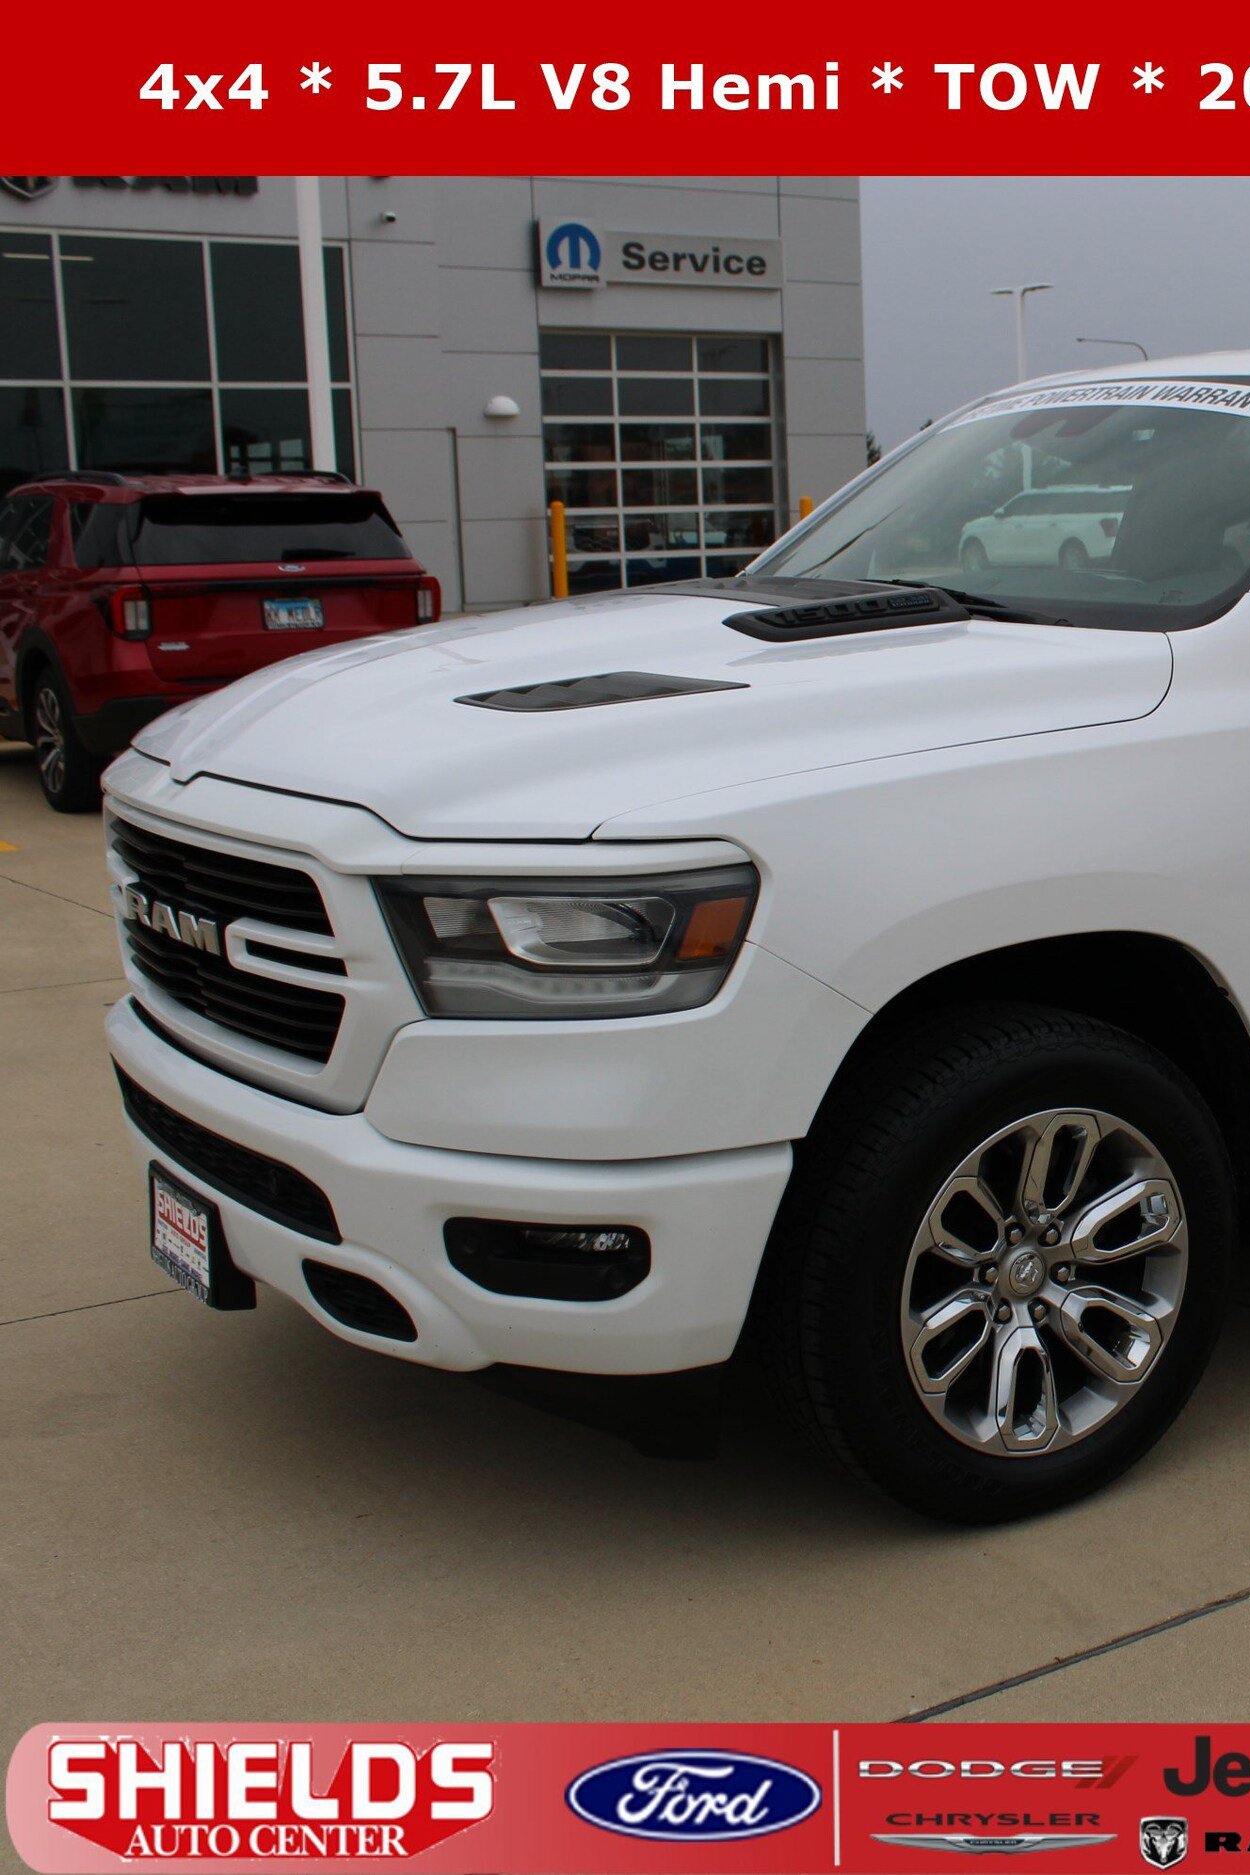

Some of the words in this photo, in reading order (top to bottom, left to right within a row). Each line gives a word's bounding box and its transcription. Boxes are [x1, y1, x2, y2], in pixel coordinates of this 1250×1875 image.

[621, 241, 767, 276] Service
[550, 272, 599, 282] MOPAR
[1022, 383, 1155, 409] POWERTRAIN
[125, 885, 221, 957] RAM
[157, 1189, 208, 1246] SHIELDS
